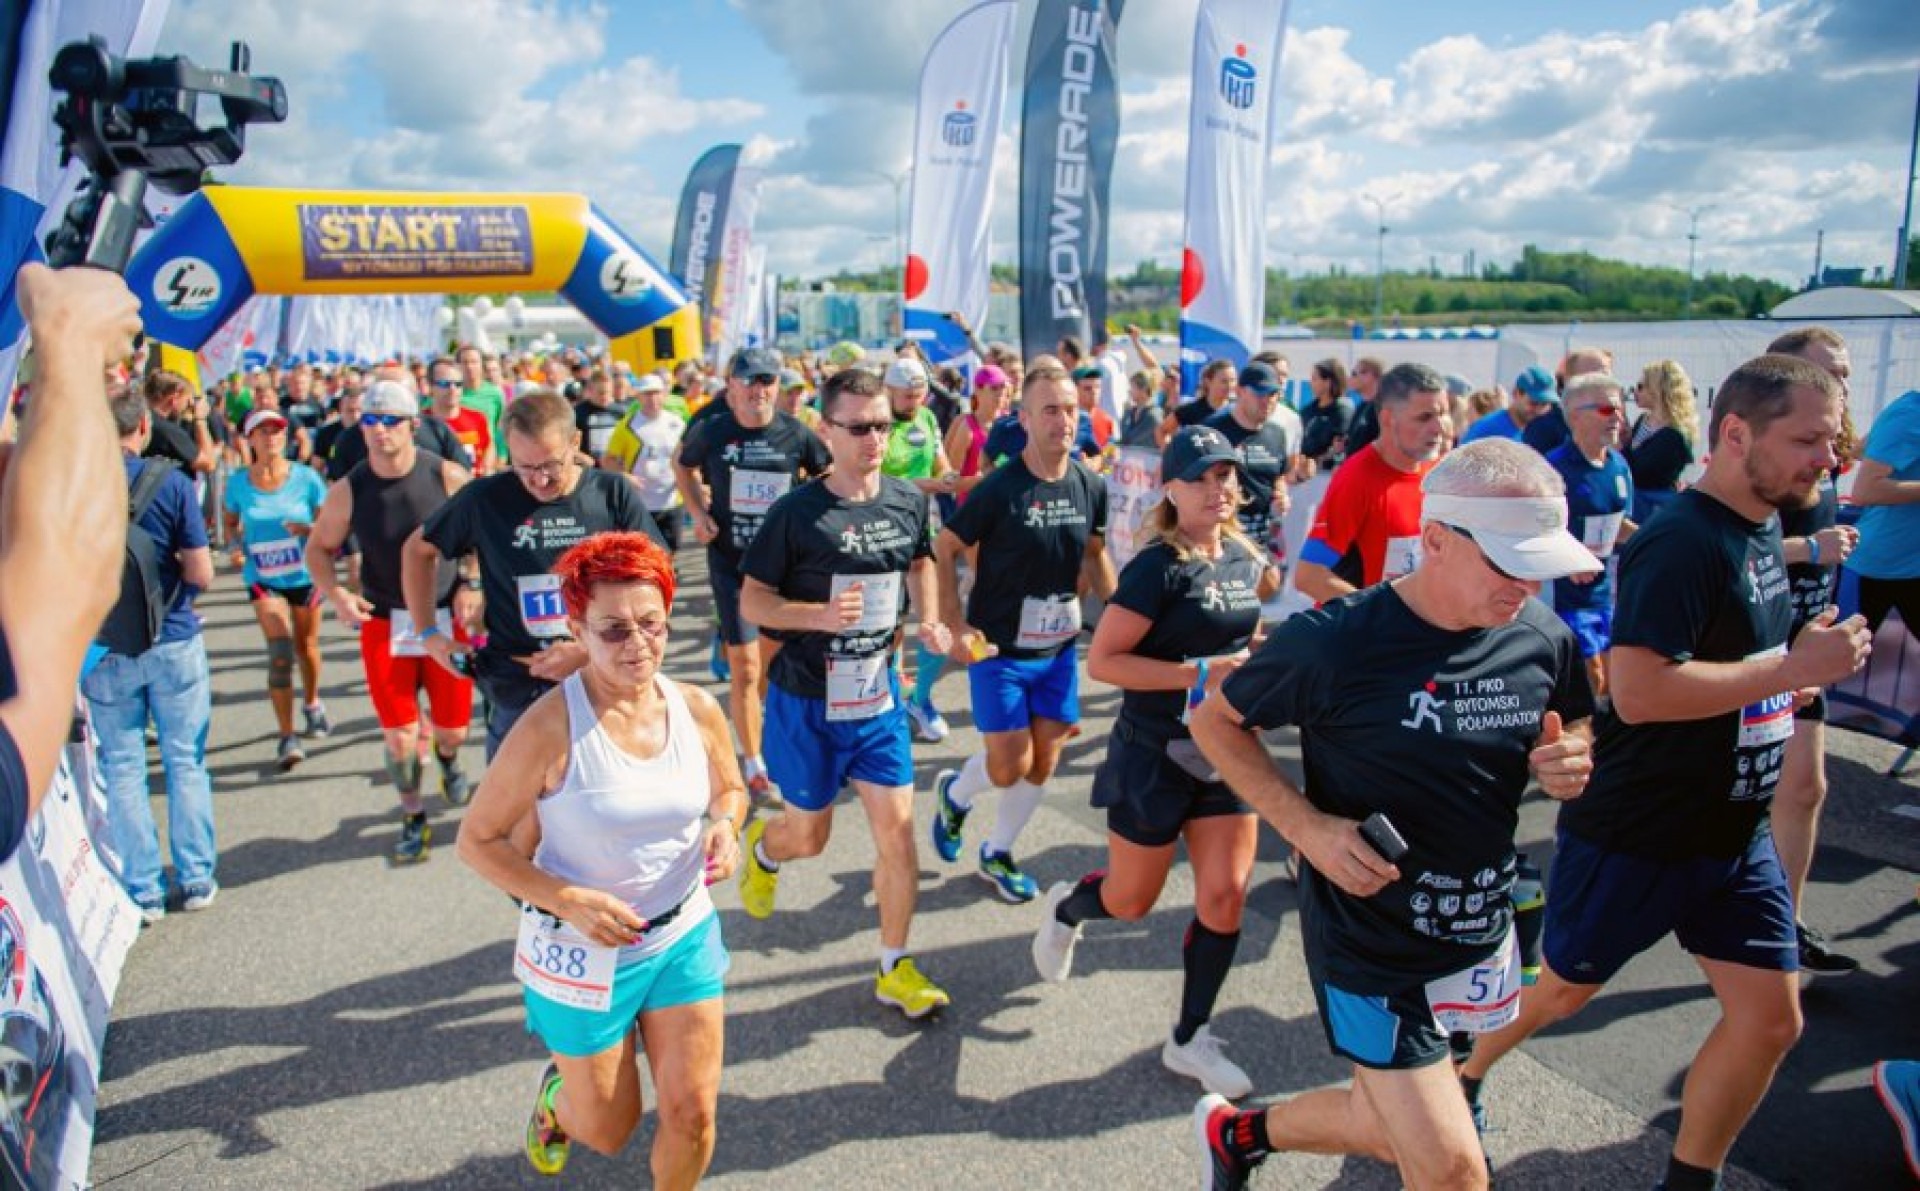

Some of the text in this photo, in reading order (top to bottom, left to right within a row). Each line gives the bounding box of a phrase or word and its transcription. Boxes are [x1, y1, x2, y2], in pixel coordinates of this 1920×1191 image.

[1050, 6, 1100, 320] POWERADE
[319, 212, 461, 251] START
[1454, 694, 1520, 714] BYTOMSKI
[1455, 678, 1504, 695] 11. PKO
[532, 935, 588, 978] 588
[1467, 968, 1506, 1002] 51
